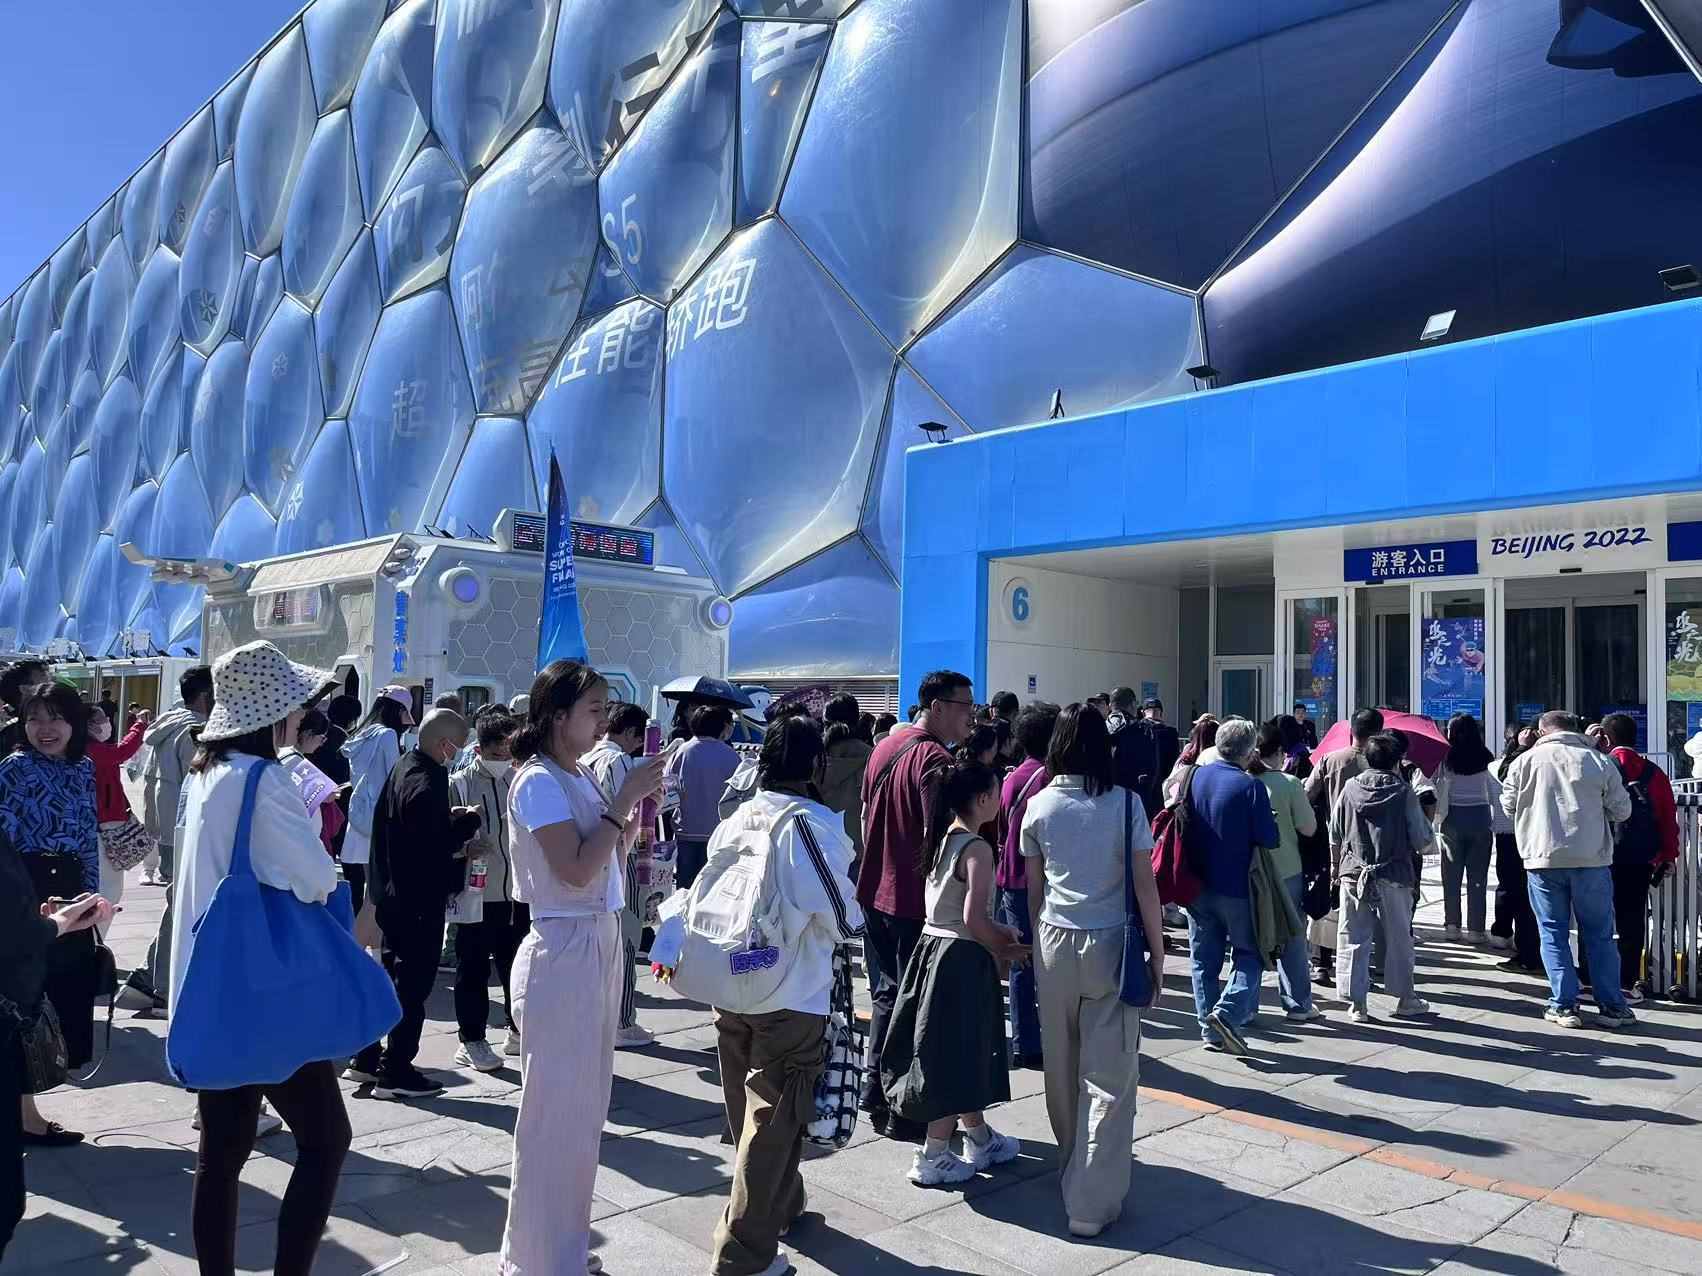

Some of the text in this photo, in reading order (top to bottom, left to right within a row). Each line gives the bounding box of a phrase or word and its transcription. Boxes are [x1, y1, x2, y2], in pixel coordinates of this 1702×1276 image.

[1491, 526, 1654, 559] BEIJING 2022
[549, 556, 574, 571] SUPE
[1371, 548, 1445, 568] 游客入口
[1371, 563, 1445, 576] ENTRANCE
[1012, 586, 1029, 621] 6
